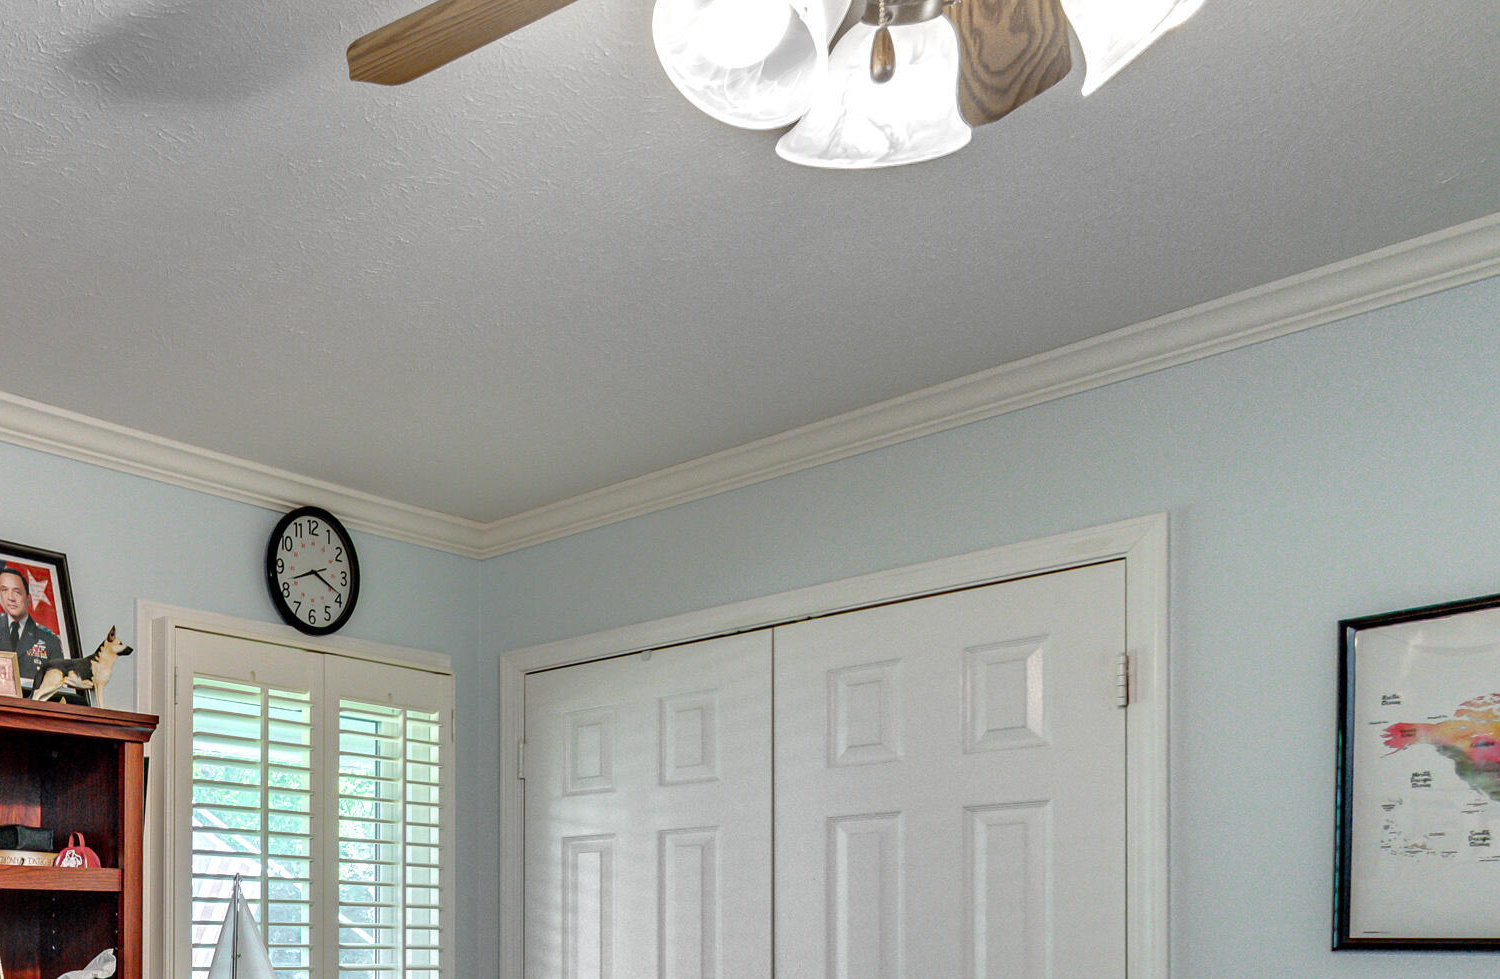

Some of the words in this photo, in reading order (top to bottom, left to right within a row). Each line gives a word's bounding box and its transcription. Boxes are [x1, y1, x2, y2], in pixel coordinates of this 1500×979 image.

[294, 522, 302, 538] 11
[307, 520, 319, 536] 12
[281, 536, 293, 551] 10
[326, 529, 331, 544] 1
[335, 547, 342, 562] 2
[276, 558, 284, 574] 9
[340, 571, 347, 587] 3
[282, 582, 290, 598] 8
[335, 593, 342, 608] 4
[293, 601, 301, 616] 7
[324, 606, 331, 621] 5
[308, 609, 316, 624] 6
